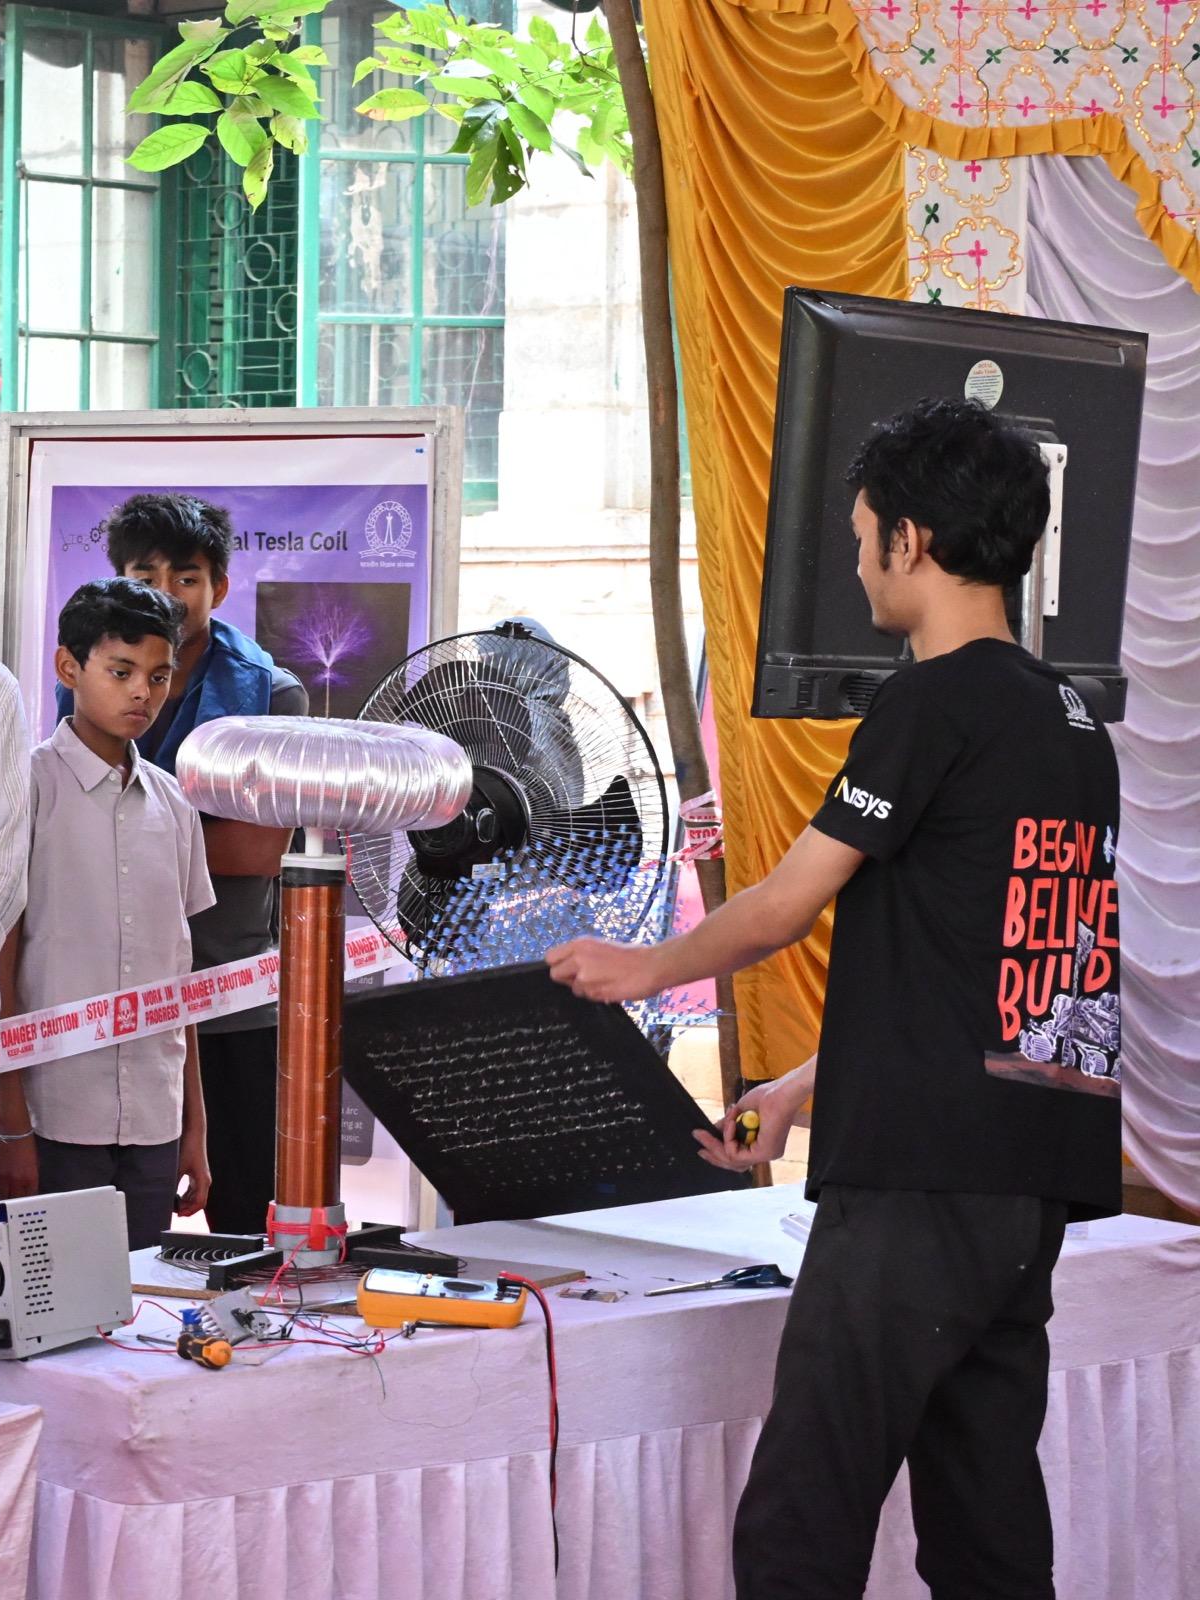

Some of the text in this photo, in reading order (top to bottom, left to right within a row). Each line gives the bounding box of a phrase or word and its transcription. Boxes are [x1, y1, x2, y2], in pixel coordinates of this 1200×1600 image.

[255, 531, 304, 551] Tesla
[310, 530, 348, 551] Coil
[346, 935, 380, 959] DANGER
[257, 956, 280, 976] STOP
[141, 985, 174, 1007] WORK IN
[180, 967, 253, 1003] DANGER CAUTION
[997, 948, 1112, 1041] BUID
[86, 999, 109, 1021] STOP
[145, 1003, 179, 1027] PROGRESS
[0, 1012, 79, 1049] DANGER CAUTION
